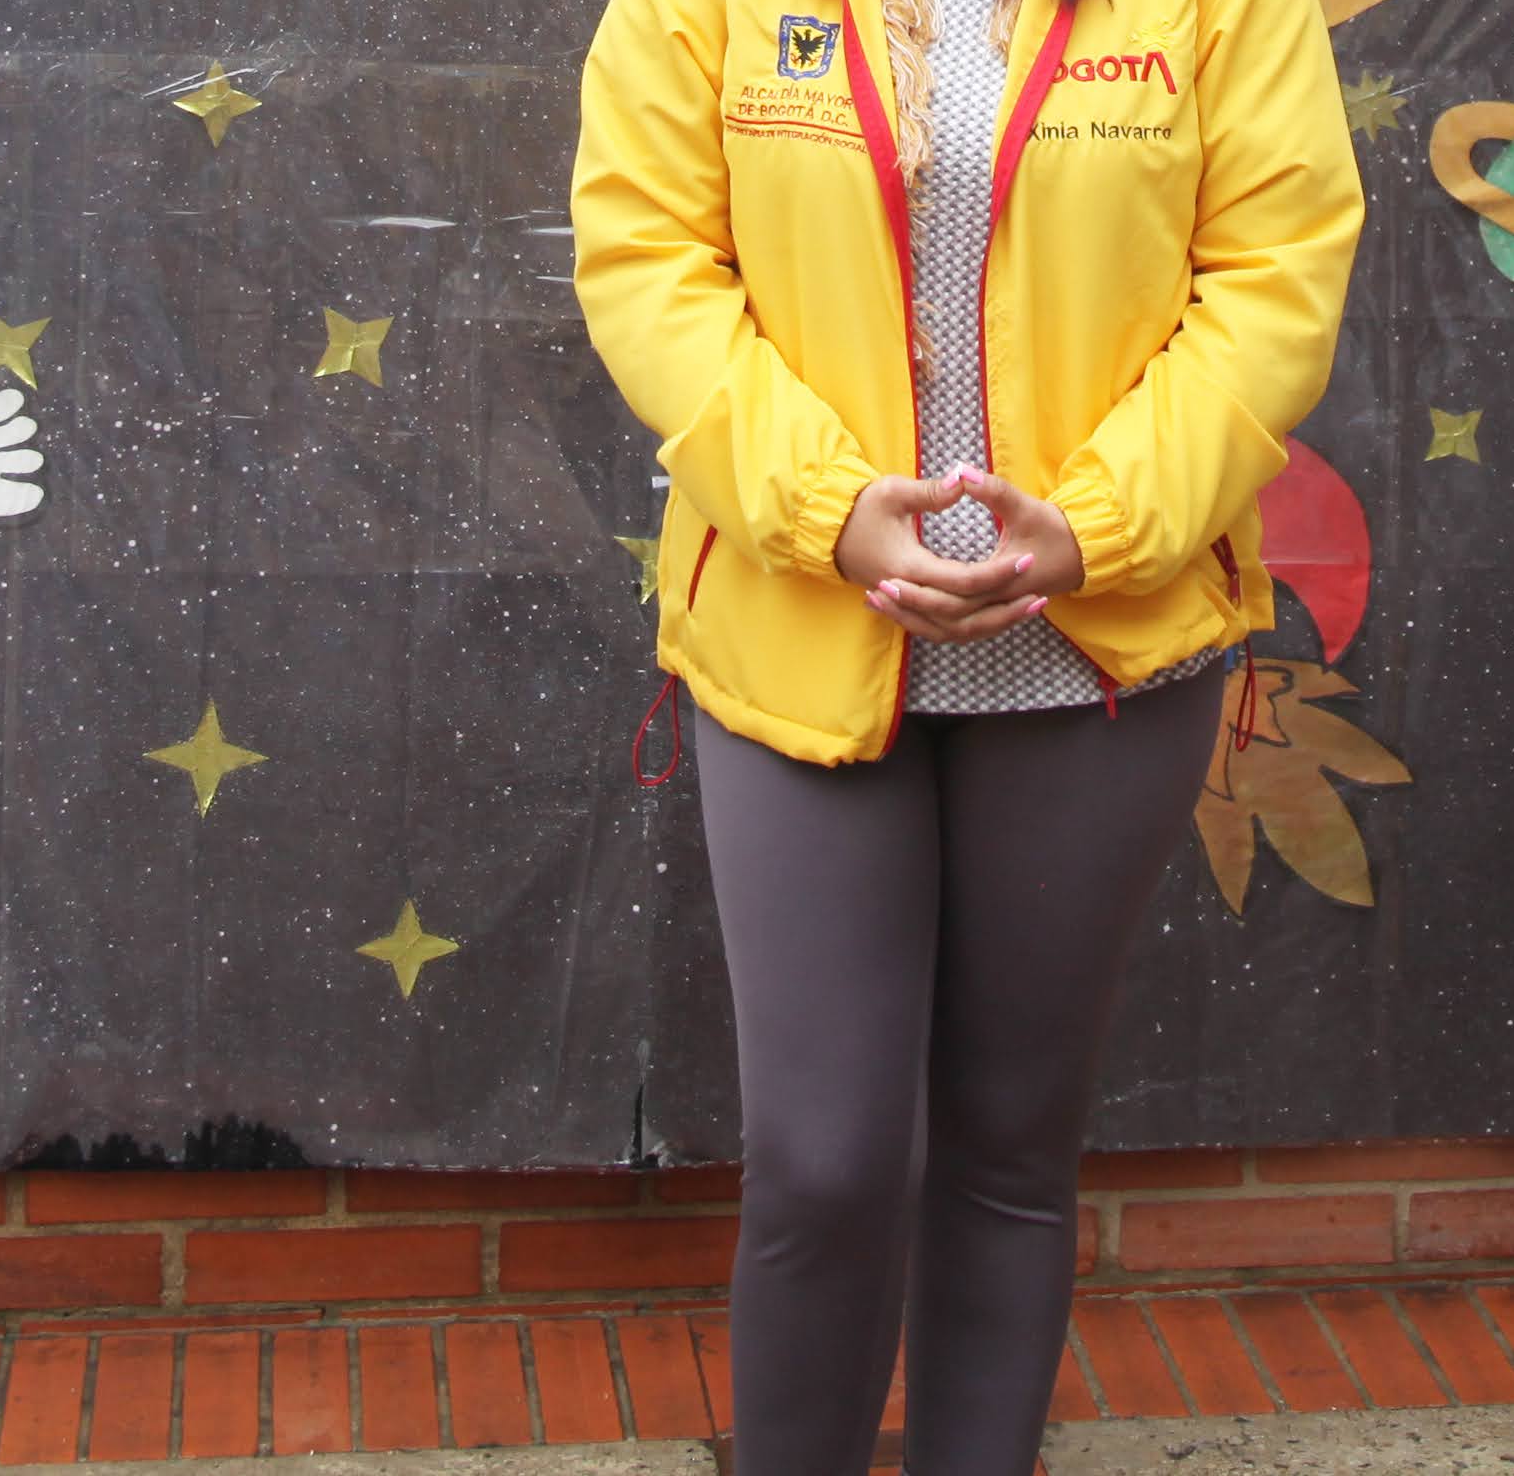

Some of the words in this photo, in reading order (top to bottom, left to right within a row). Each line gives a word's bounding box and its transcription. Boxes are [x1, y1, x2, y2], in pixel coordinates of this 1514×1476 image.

[737, 103, 757, 116] DE
[803, 89, 854, 110] MAYOR
[1090, 121, 1173, 141] Navarro
